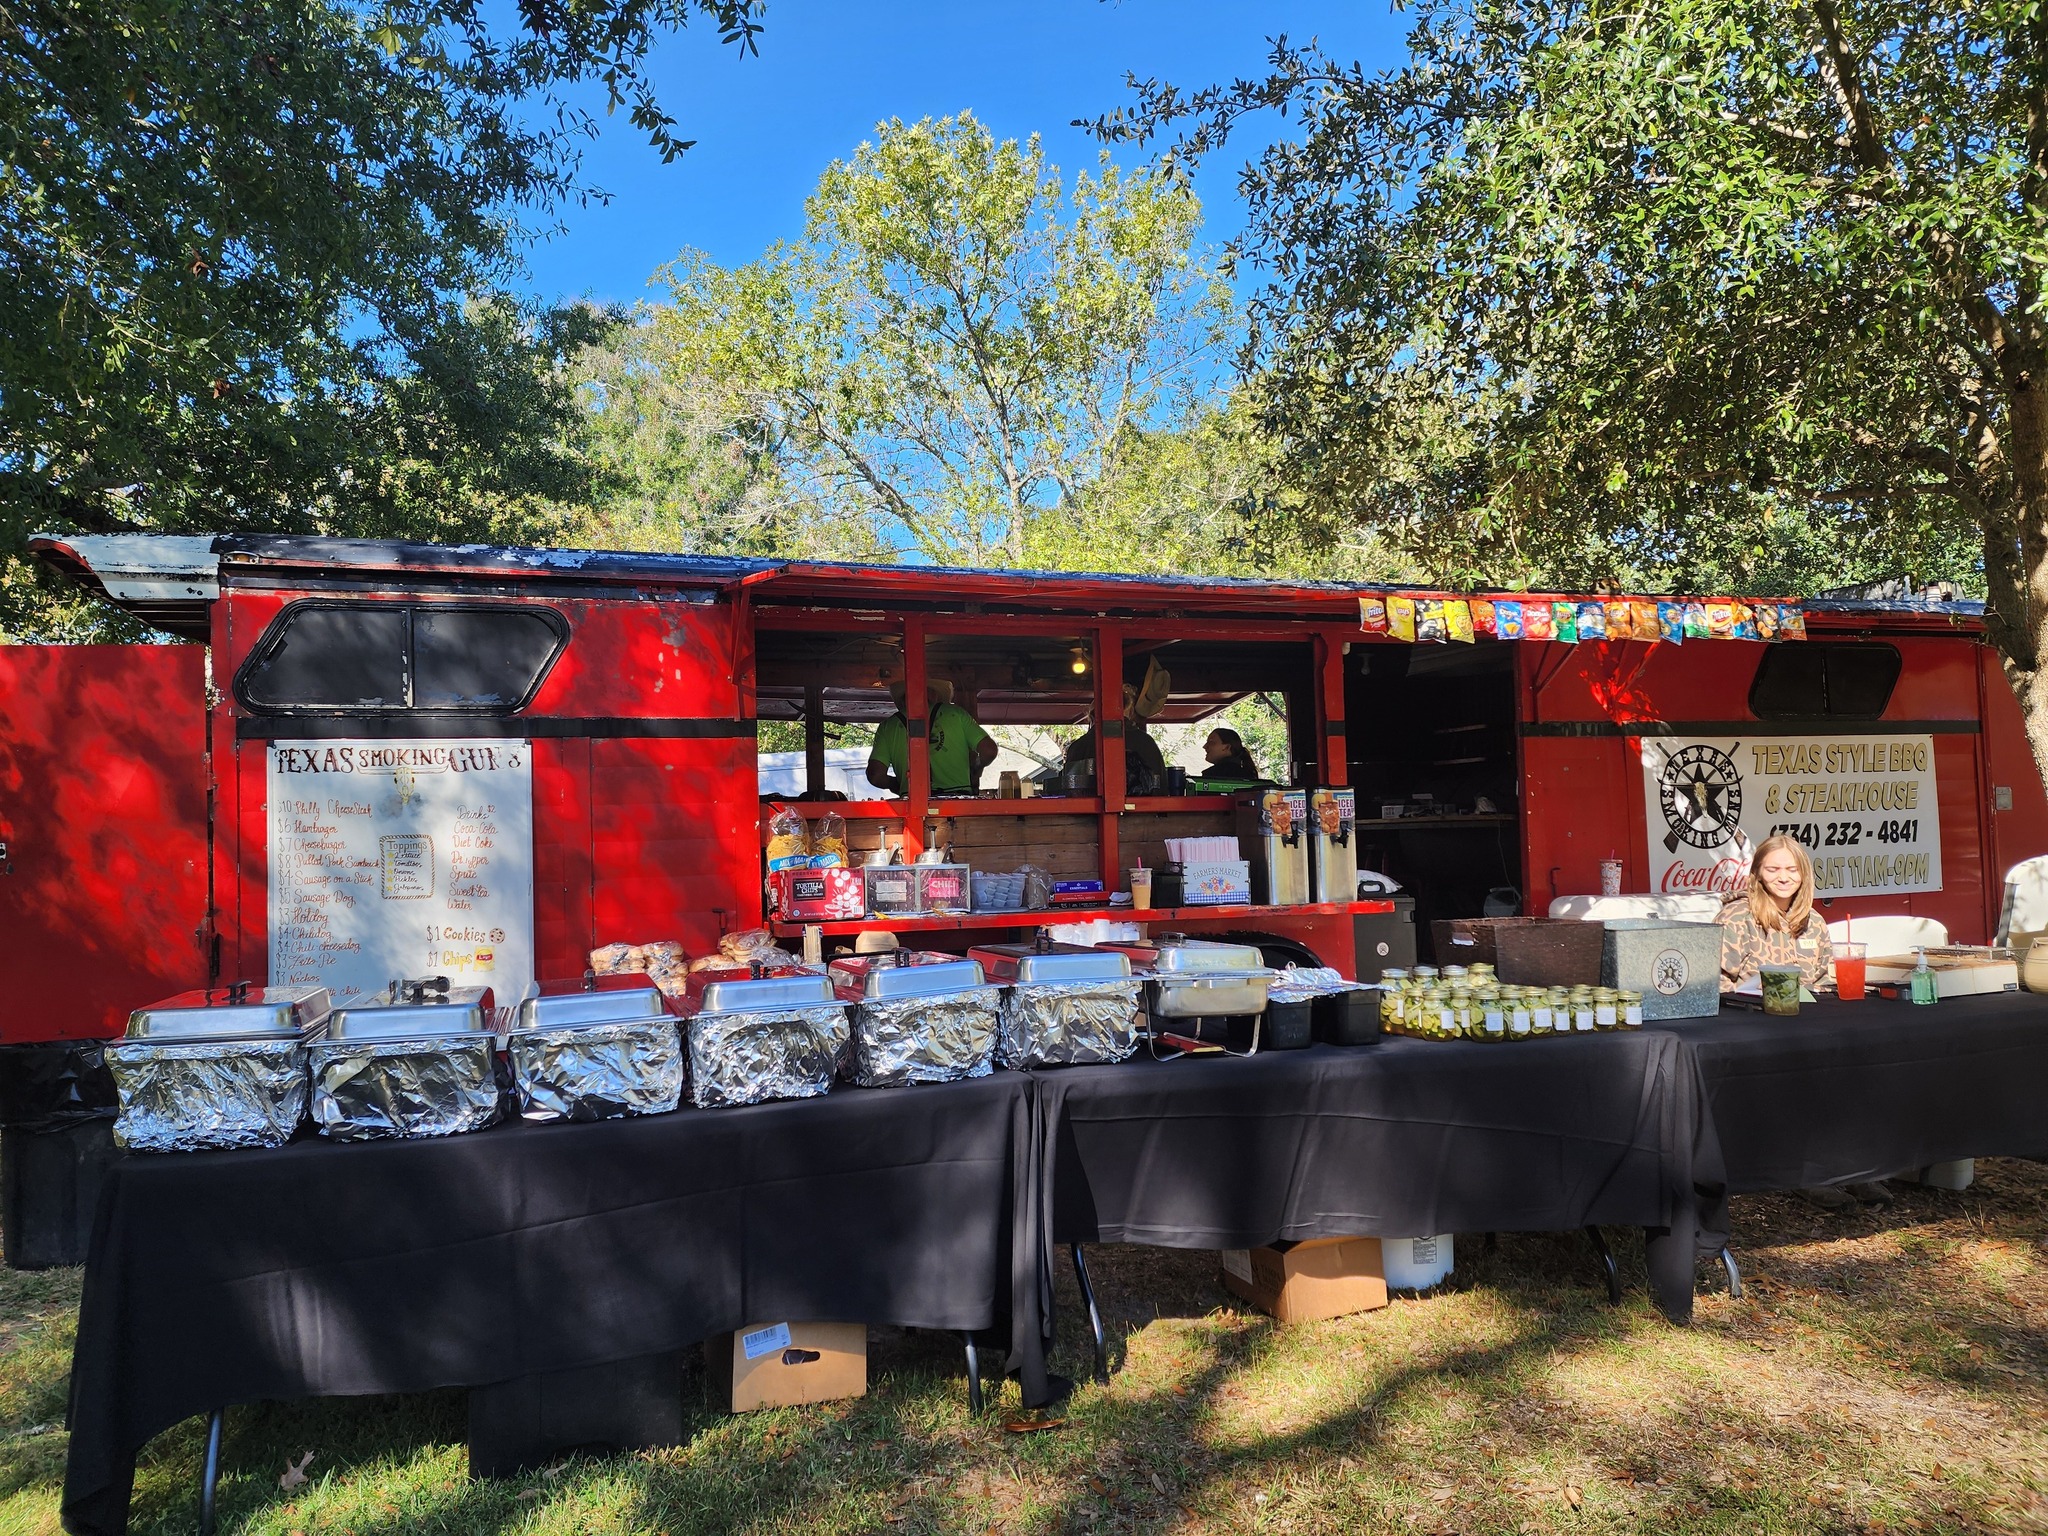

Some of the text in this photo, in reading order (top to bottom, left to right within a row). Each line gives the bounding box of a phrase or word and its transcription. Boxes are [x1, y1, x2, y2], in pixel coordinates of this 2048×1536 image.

[274, 747, 354, 773] TEXAS
[359, 748, 445, 768] SMOKING
[1752, 742, 1929, 775] TEXAS STYLE BBQ
[1290, 799, 1306, 809] ICED
[1338, 799, 1354, 809] ICED
[1765, 780, 1920, 815] & STEAKHOUSE
[295, 801, 320, 821] Philly
[457, 804, 489, 820] Drinks
[1291, 809, 1304, 818] TEA
[1339, 808, 1352, 818] TEA
[277, 817, 291, 834] $6
[453, 820, 499, 834] Coca-Cola
[1824, 820, 1863, 847] 232
[1877, 818, 1919, 844] 4841
[278, 836, 347, 854] $7 Cheeseburger
[386, 840, 427, 854] Toppings
[453, 834, 494, 849] Diet Coke
[278, 852, 291, 869] $8
[293, 852, 323, 868] Pulled
[324, 853, 345, 869] Pork
[465, 855, 490, 869] pper
[449, 865, 477, 882] Sprite
[1192, 867, 1242, 880] FARMERS MARKET
[1847, 852, 1931, 889] 11AM-9PM
[278, 870, 292, 887] $4
[294, 870, 332, 888] Sausage
[353, 871, 374, 886] Stick
[796, 882, 824, 890] TORTILLA
[449, 882, 475, 897] Sweet
[278, 887, 356, 909] $5 Sausage Dog
[447, 898, 472, 911] Water
[278, 907, 330, 929] $3 Hotdog
[278, 926, 290, 940] $4
[426, 925, 486, 943] $1 Cookies
[277, 941, 290, 953] $4
[275, 952, 287, 969] $3
[318, 952, 337, 968] Pie
[426, 950, 472, 973] $1 Chips
[289, 971, 320, 987] Nachos
